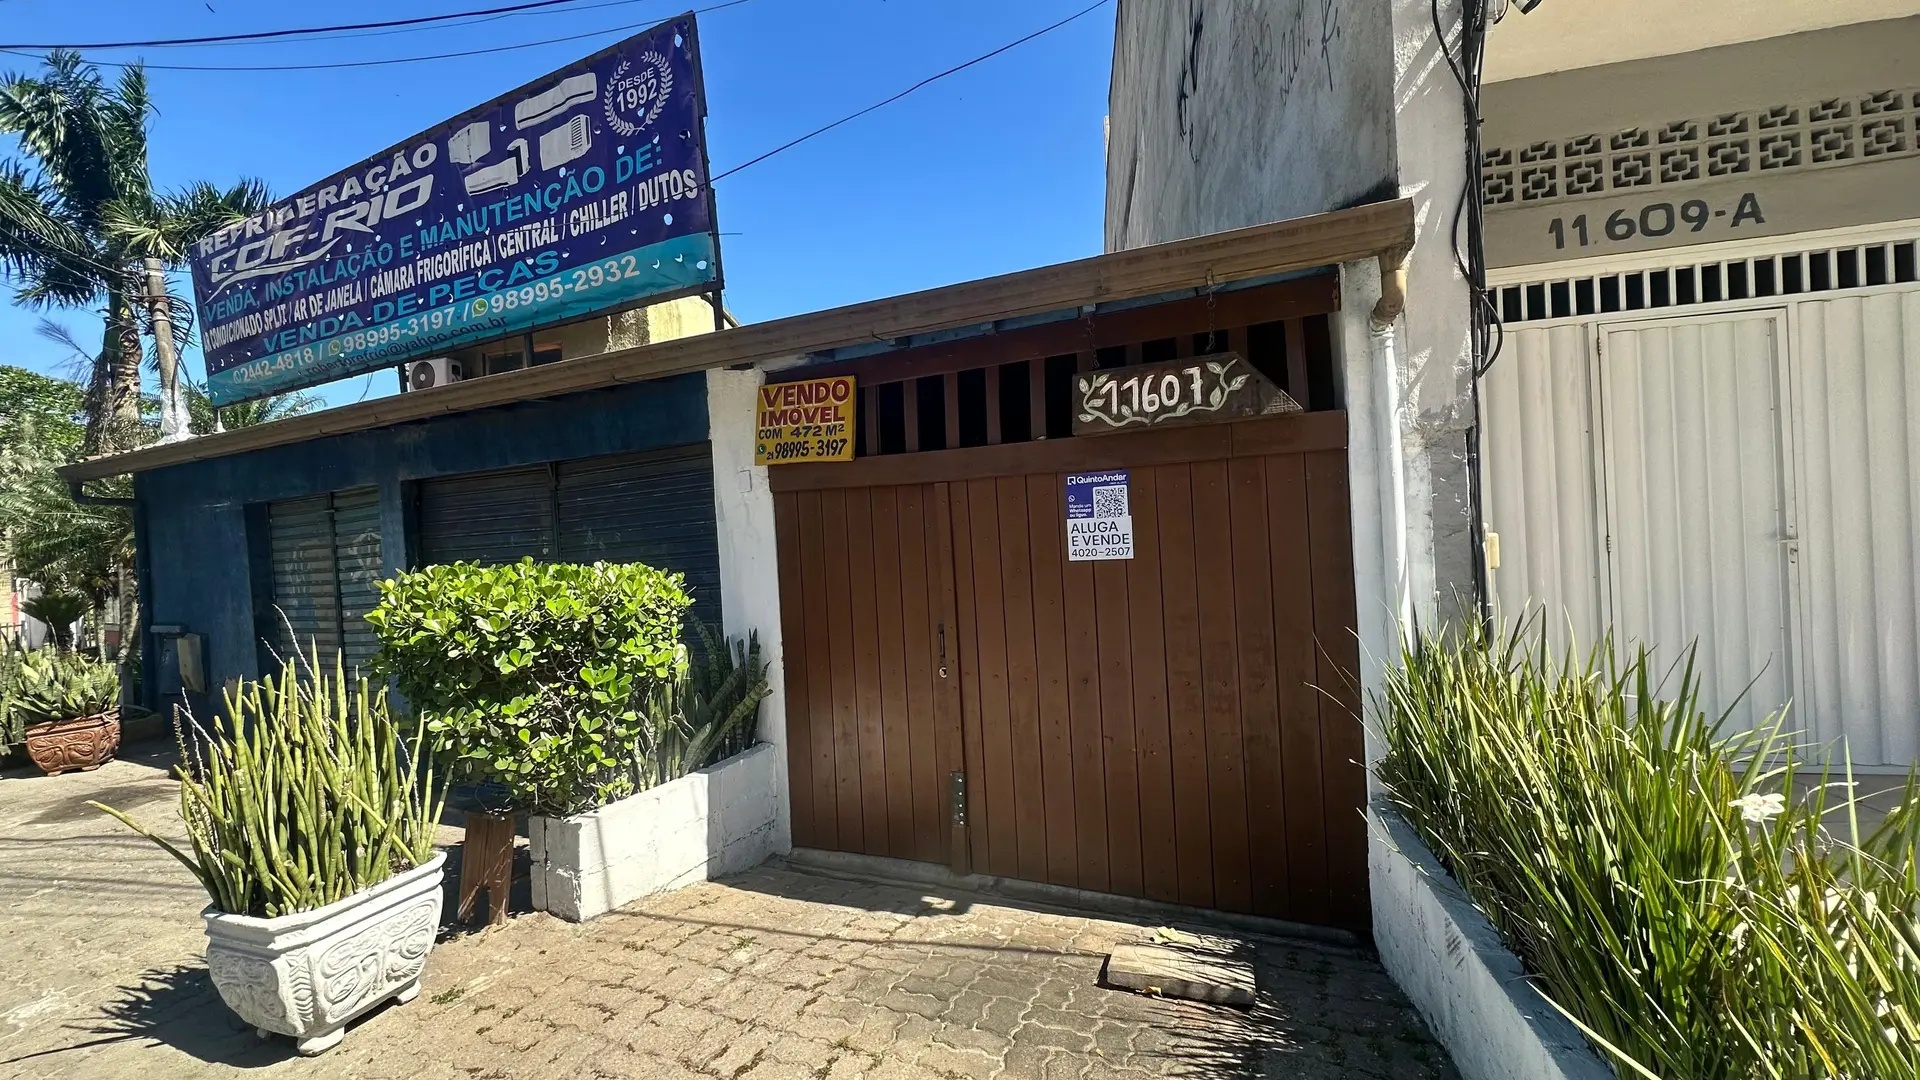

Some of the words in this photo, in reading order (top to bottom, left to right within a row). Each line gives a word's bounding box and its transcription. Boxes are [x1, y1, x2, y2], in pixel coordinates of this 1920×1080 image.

[618, 67, 654, 91] DESDE
[617, 78, 657, 112] 1992
[205, 289, 260, 321] VENDA,
[265, 243, 393, 301] INSTALAÇÃO
[400, 234, 414, 258] E
[420, 166, 605, 251] MANUTENÇÃO
[616, 143, 662, 184] DE:
[210, 312, 263, 350] CONDICIONADO
[264, 303, 288, 331] SPLIT
[294, 299, 308, 322] AR
[309, 294, 323, 317] DE
[325, 281, 362, 314] JANELA
[370, 268, 415, 299] CÂMARA
[417, 241, 492, 285] FRIGORÍFICA
[498, 217, 559, 259] CENTRAL
[570, 191, 628, 237] CHILLER
[639, 169, 698, 211] DUTOS
[263, 311, 365, 353] VENDA
[373, 293, 417, 322] DE
[429, 250, 559, 305] PEÇAS
[343, 308, 453, 352] 98995-3197
[491, 255, 640, 313] 98995-2932
[761, 379, 850, 409] VENDO
[1099, 366, 1203, 415] 11607
[760, 405, 845, 428] IMÓVEL
[759, 428, 782, 440] COM
[791, 425, 822, 437] 472
[766, 452, 773, 460] 21
[775, 438, 848, 459] 98995-3197
[1076, 474, 1127, 483] QuintoAndar
[1071, 521, 1119, 534] ALUGA
[1071, 536, 1079, 546] E
[1082, 533, 1130, 546] VENDE
[1071, 547, 1130, 557] 4020-2507
